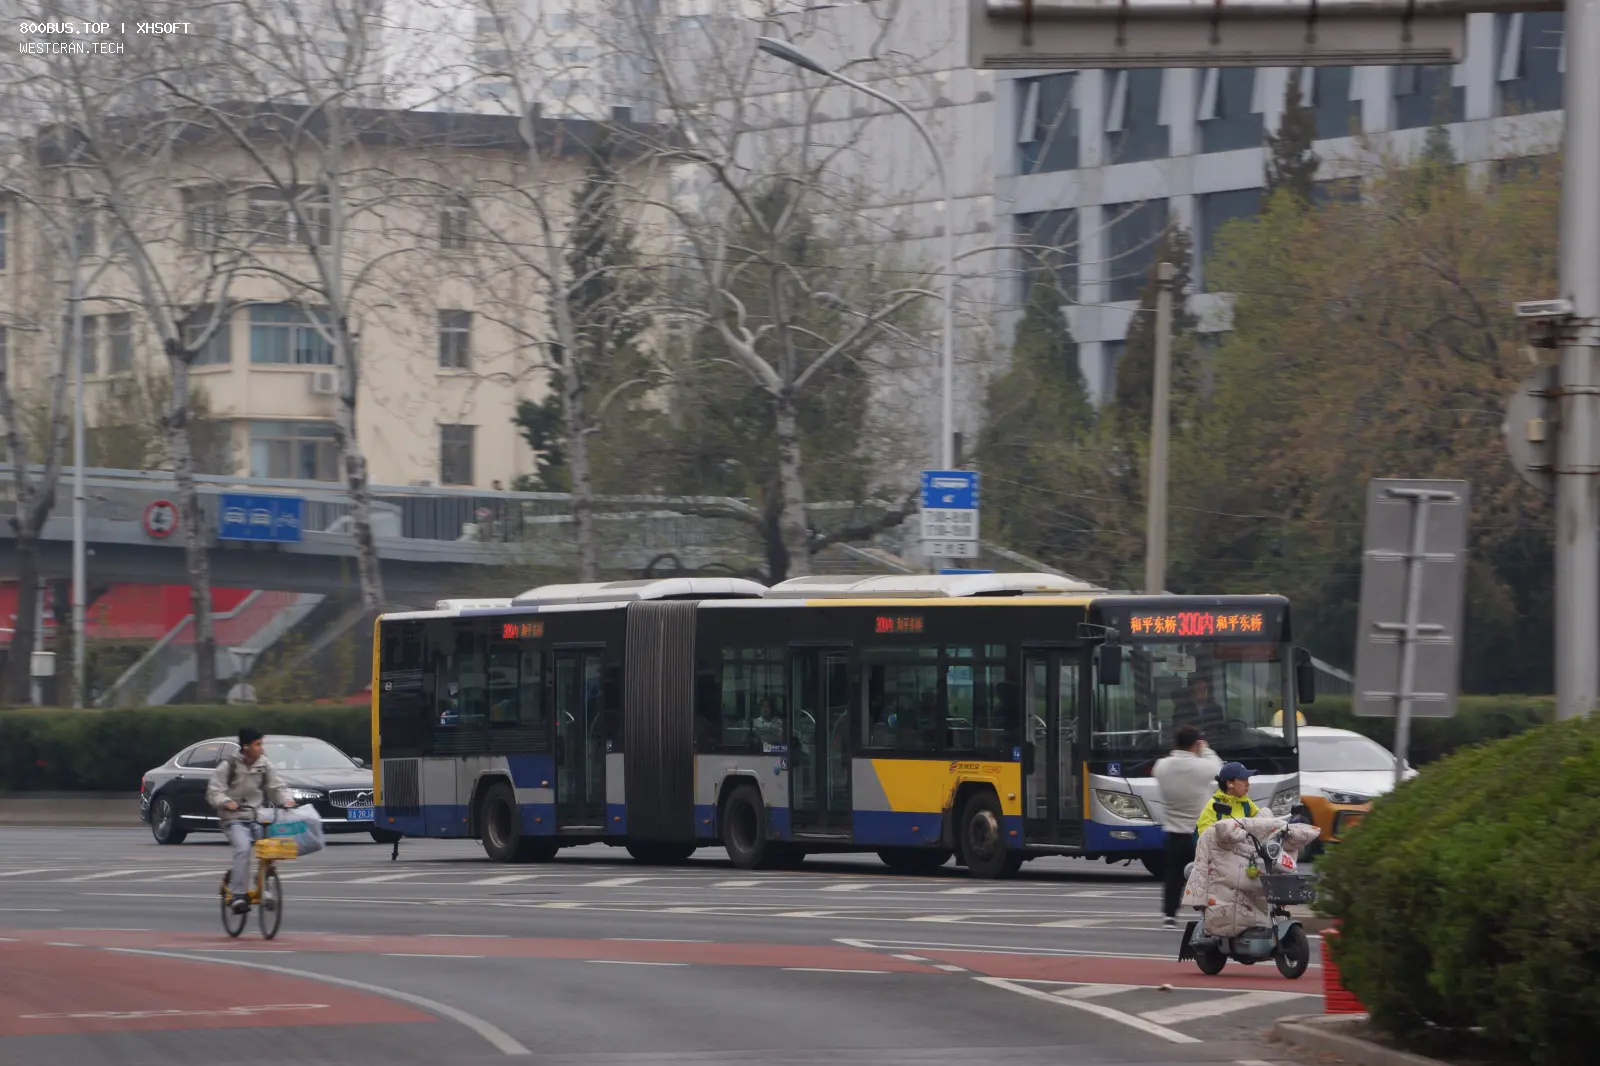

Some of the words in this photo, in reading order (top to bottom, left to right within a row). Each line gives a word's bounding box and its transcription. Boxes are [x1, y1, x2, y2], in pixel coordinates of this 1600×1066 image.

[1130, 615, 1177, 634] 和平东桥
[1216, 613, 1263, 632] 和平东桥
